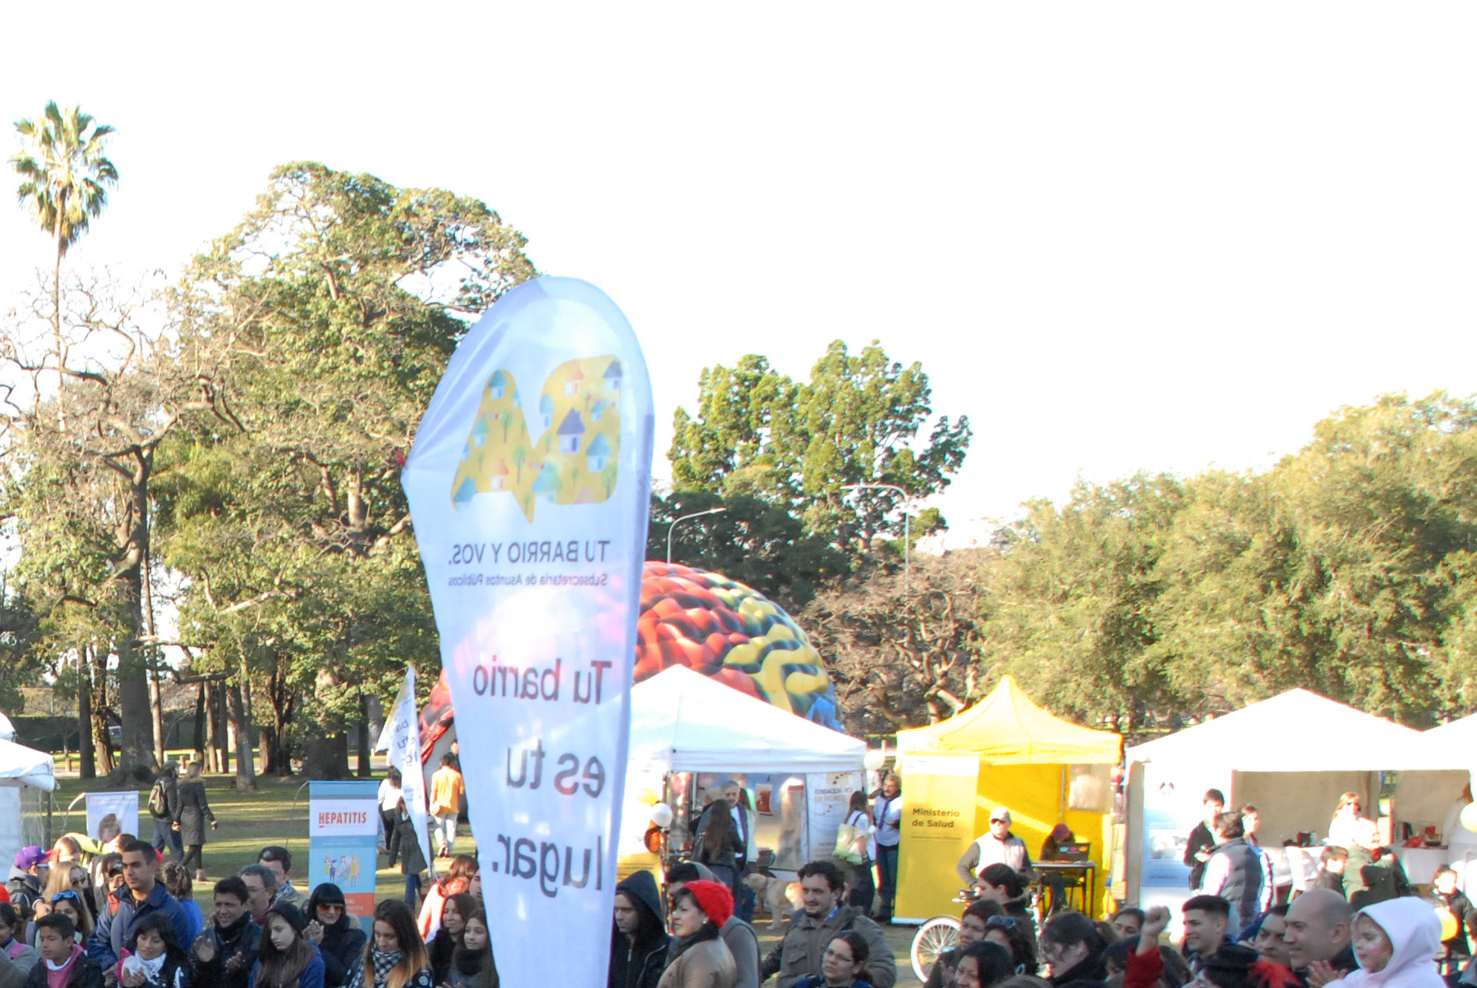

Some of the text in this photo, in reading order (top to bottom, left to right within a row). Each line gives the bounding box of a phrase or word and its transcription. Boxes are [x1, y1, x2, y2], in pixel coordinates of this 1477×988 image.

[318, 811, 367, 825] HEPATITIS
[912, 807, 960, 818] Ministerio
[911, 820, 954, 829] de Salud
